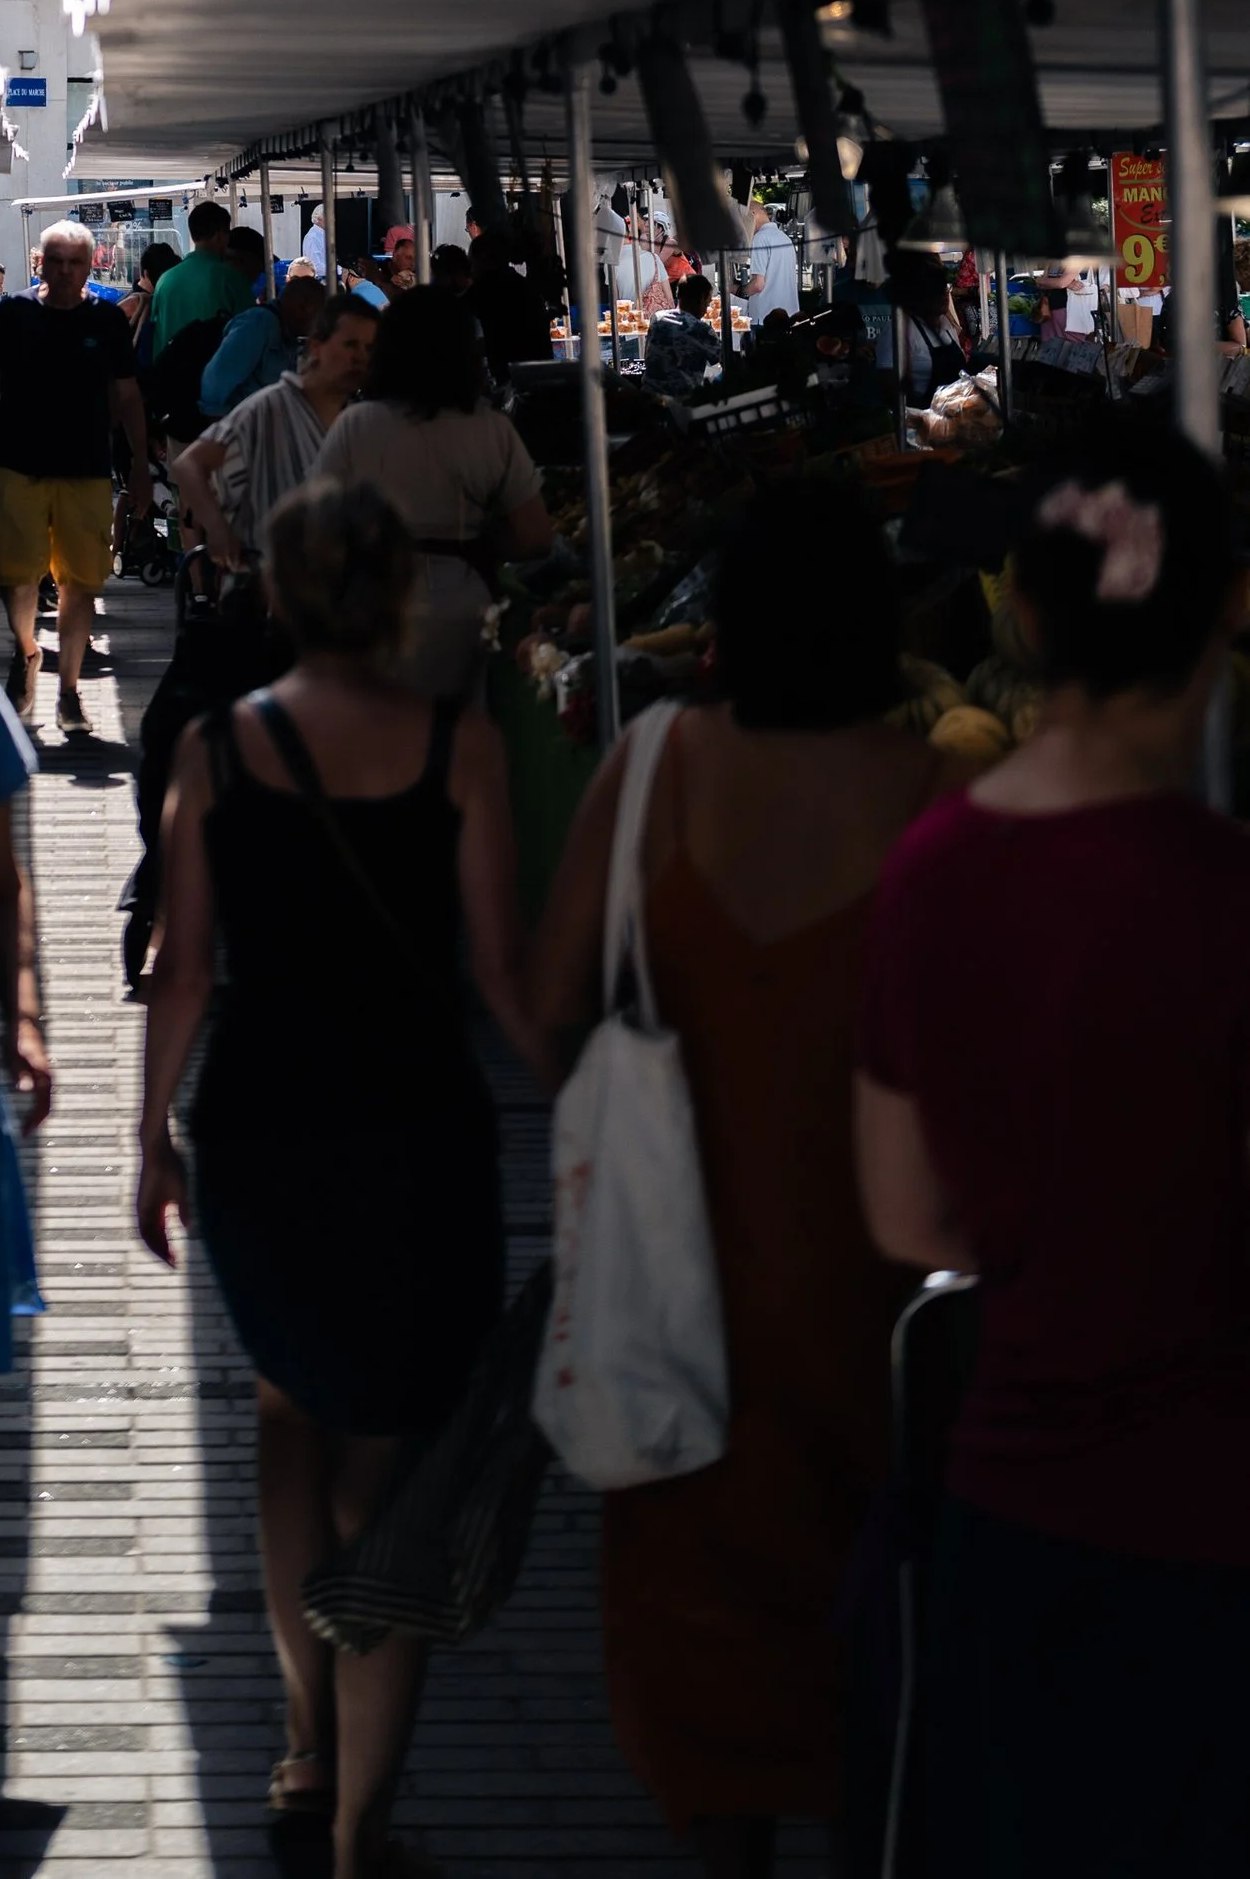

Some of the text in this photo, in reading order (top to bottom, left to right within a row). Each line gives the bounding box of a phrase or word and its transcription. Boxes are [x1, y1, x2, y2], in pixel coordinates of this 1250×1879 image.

[8, 88, 21, 96] PLACE
[21, 88, 28, 96] DU
[1119, 156, 1153, 180] Super
